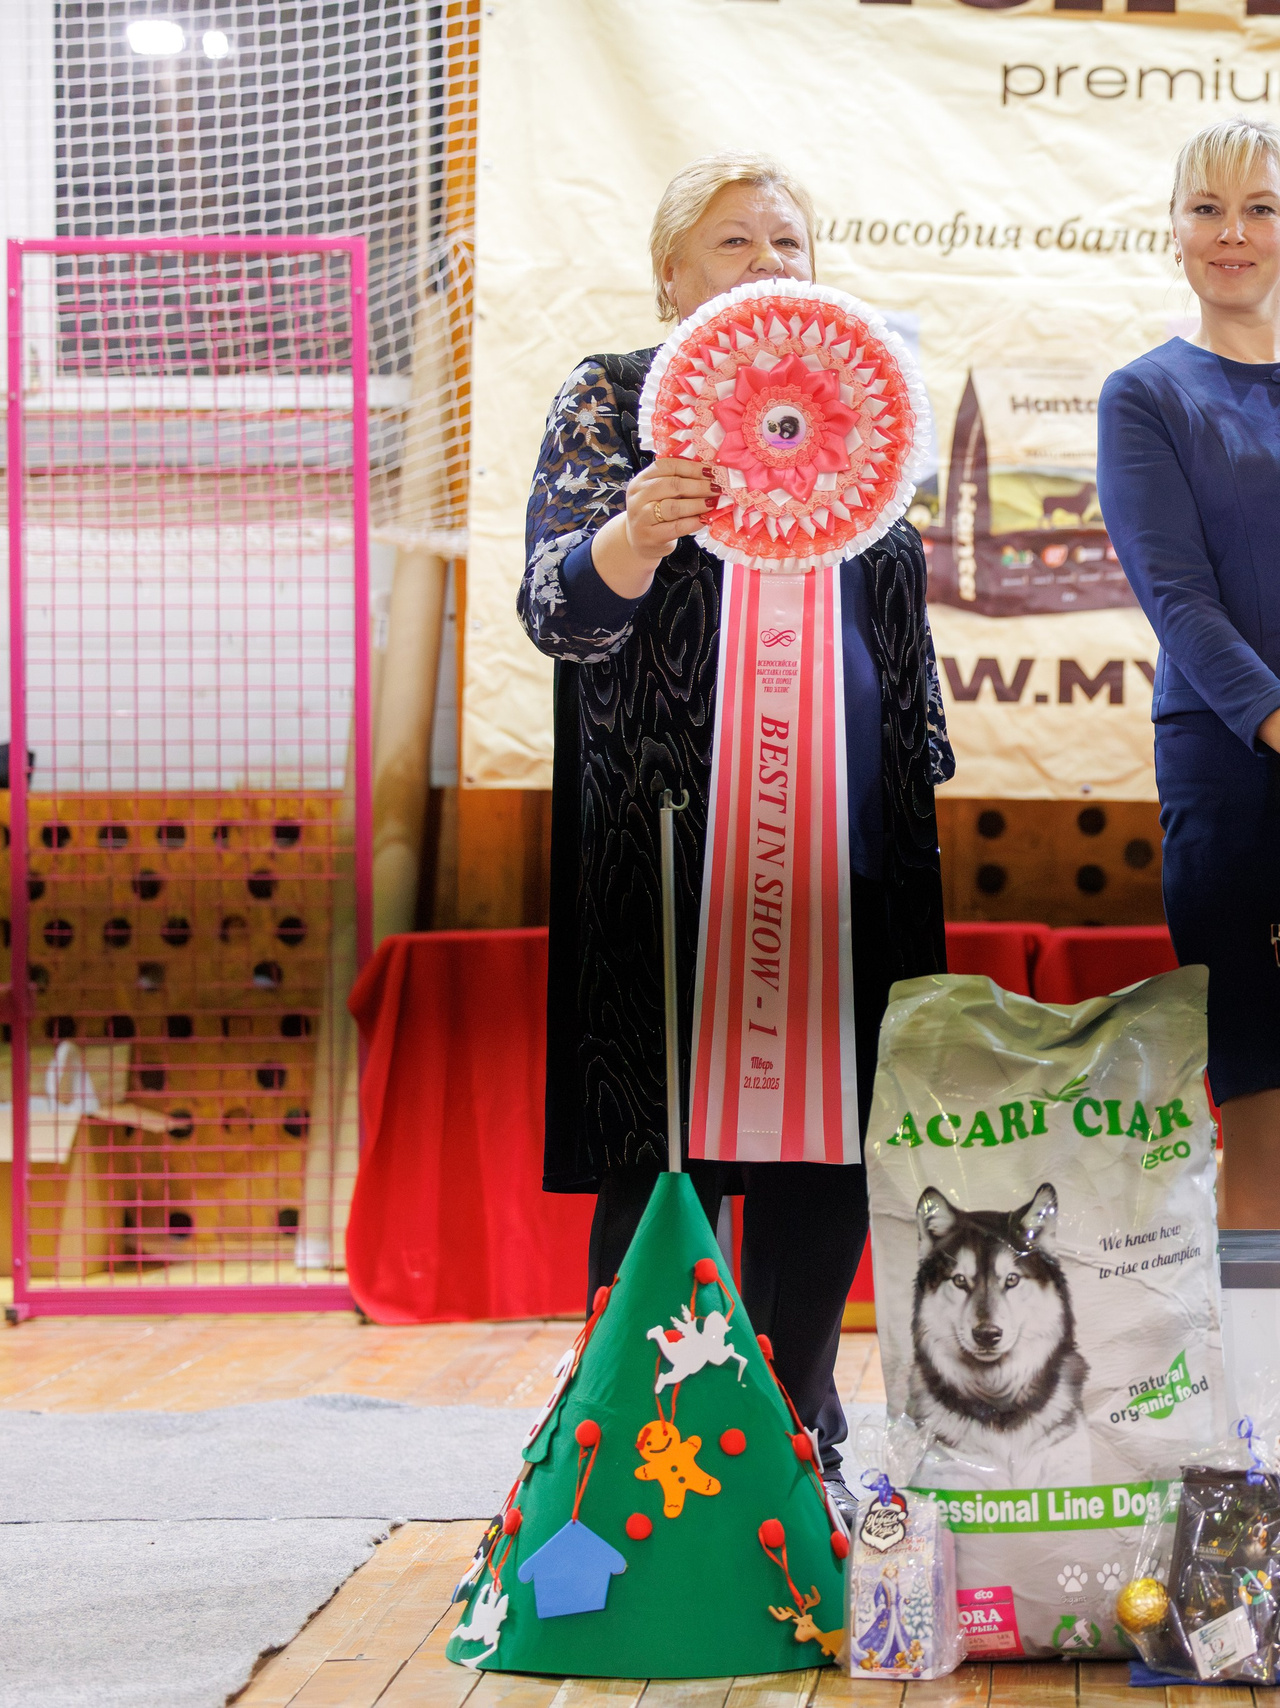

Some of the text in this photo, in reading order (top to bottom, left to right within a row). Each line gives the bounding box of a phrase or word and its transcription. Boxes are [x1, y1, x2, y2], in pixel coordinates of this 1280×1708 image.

[815, 211, 1022, 257] илософия
[758, 713, 790, 814] BEST
[756, 818, 787, 869] IN
[750, 873, 785, 993] SHOW
[744, 1076, 780, 1090] 21.12.2025
[751, 1056, 774, 1075] Тверь
[886, 1096, 1194, 1148] ACARI CIAR
[1099, 1224, 1181, 1252] We know how
[1099, 1246, 1201, 1279] to rise a champion
[1109, 1375, 1209, 1423] organic food
[1128, 1363, 1184, 1397] natural
[1048, 1491, 1104, 1521] Line
[1112, 1487, 1161, 1522] Dog
